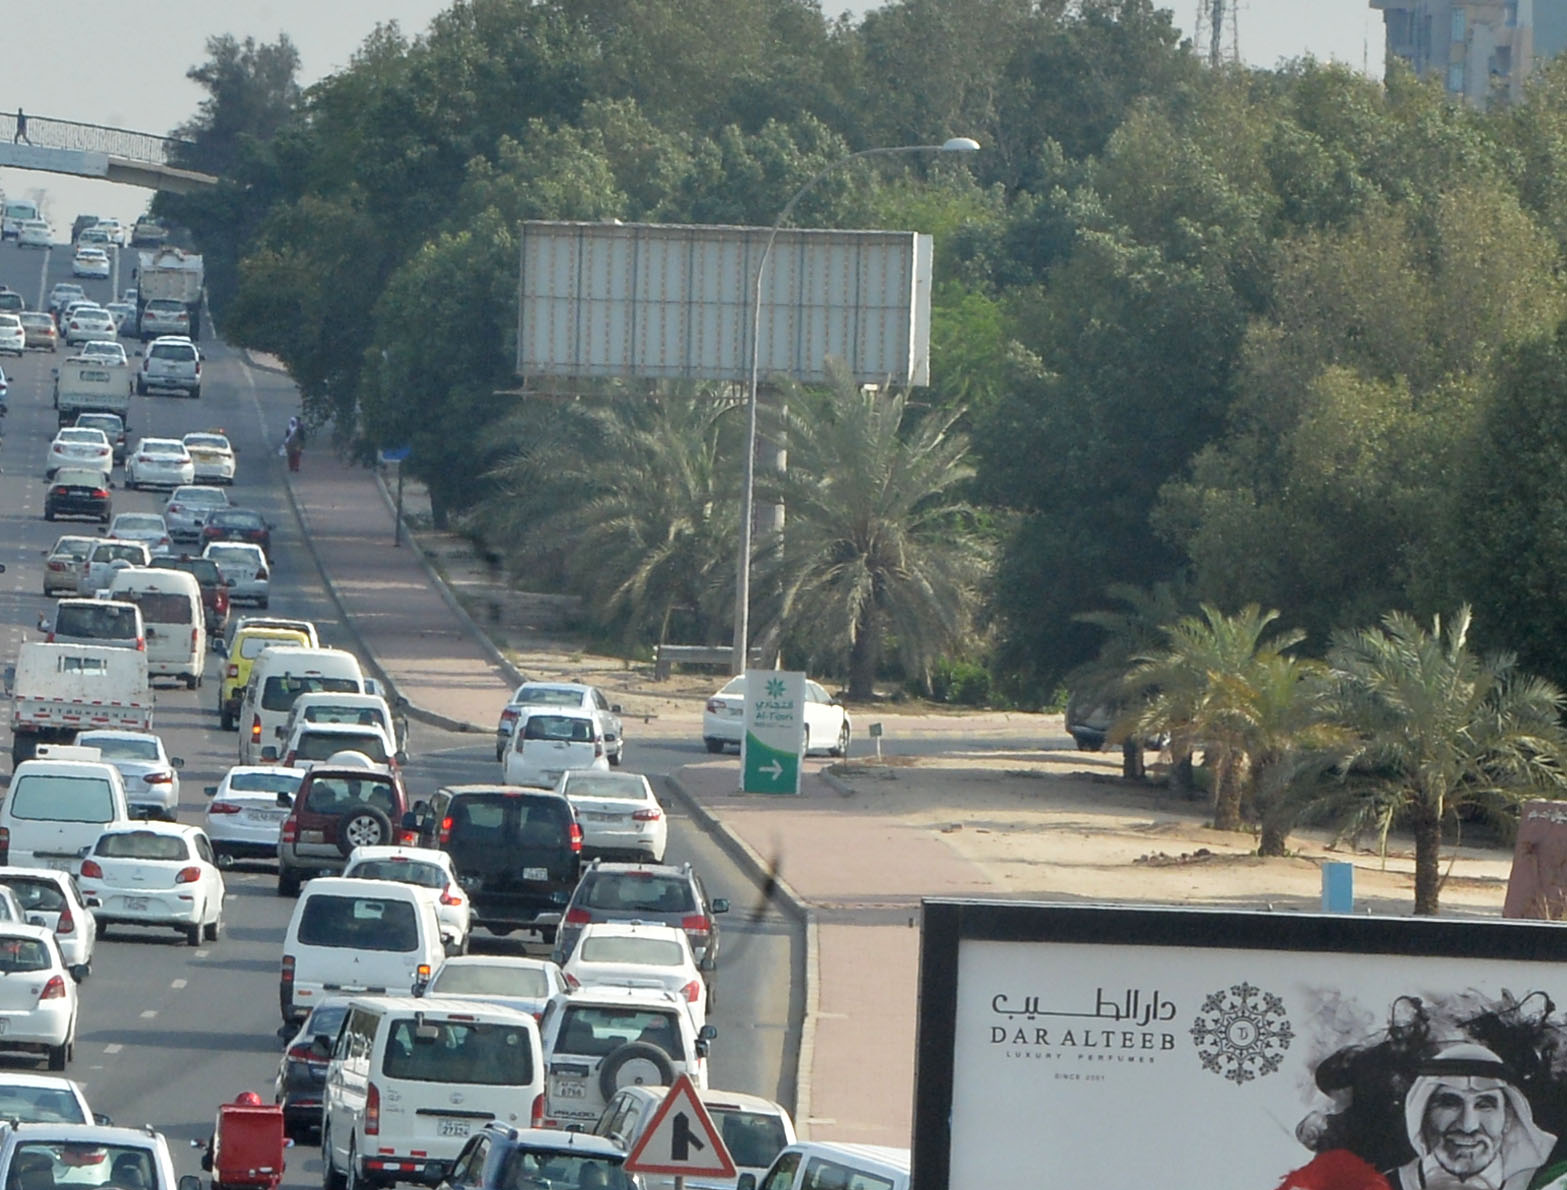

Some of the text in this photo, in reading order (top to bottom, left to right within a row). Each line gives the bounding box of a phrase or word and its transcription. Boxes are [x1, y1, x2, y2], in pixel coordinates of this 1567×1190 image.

[991, 1027, 1176, 1051] DAR ALTEEB
[1006, 1051, 1155, 1064] LUXURY PERFUMES
